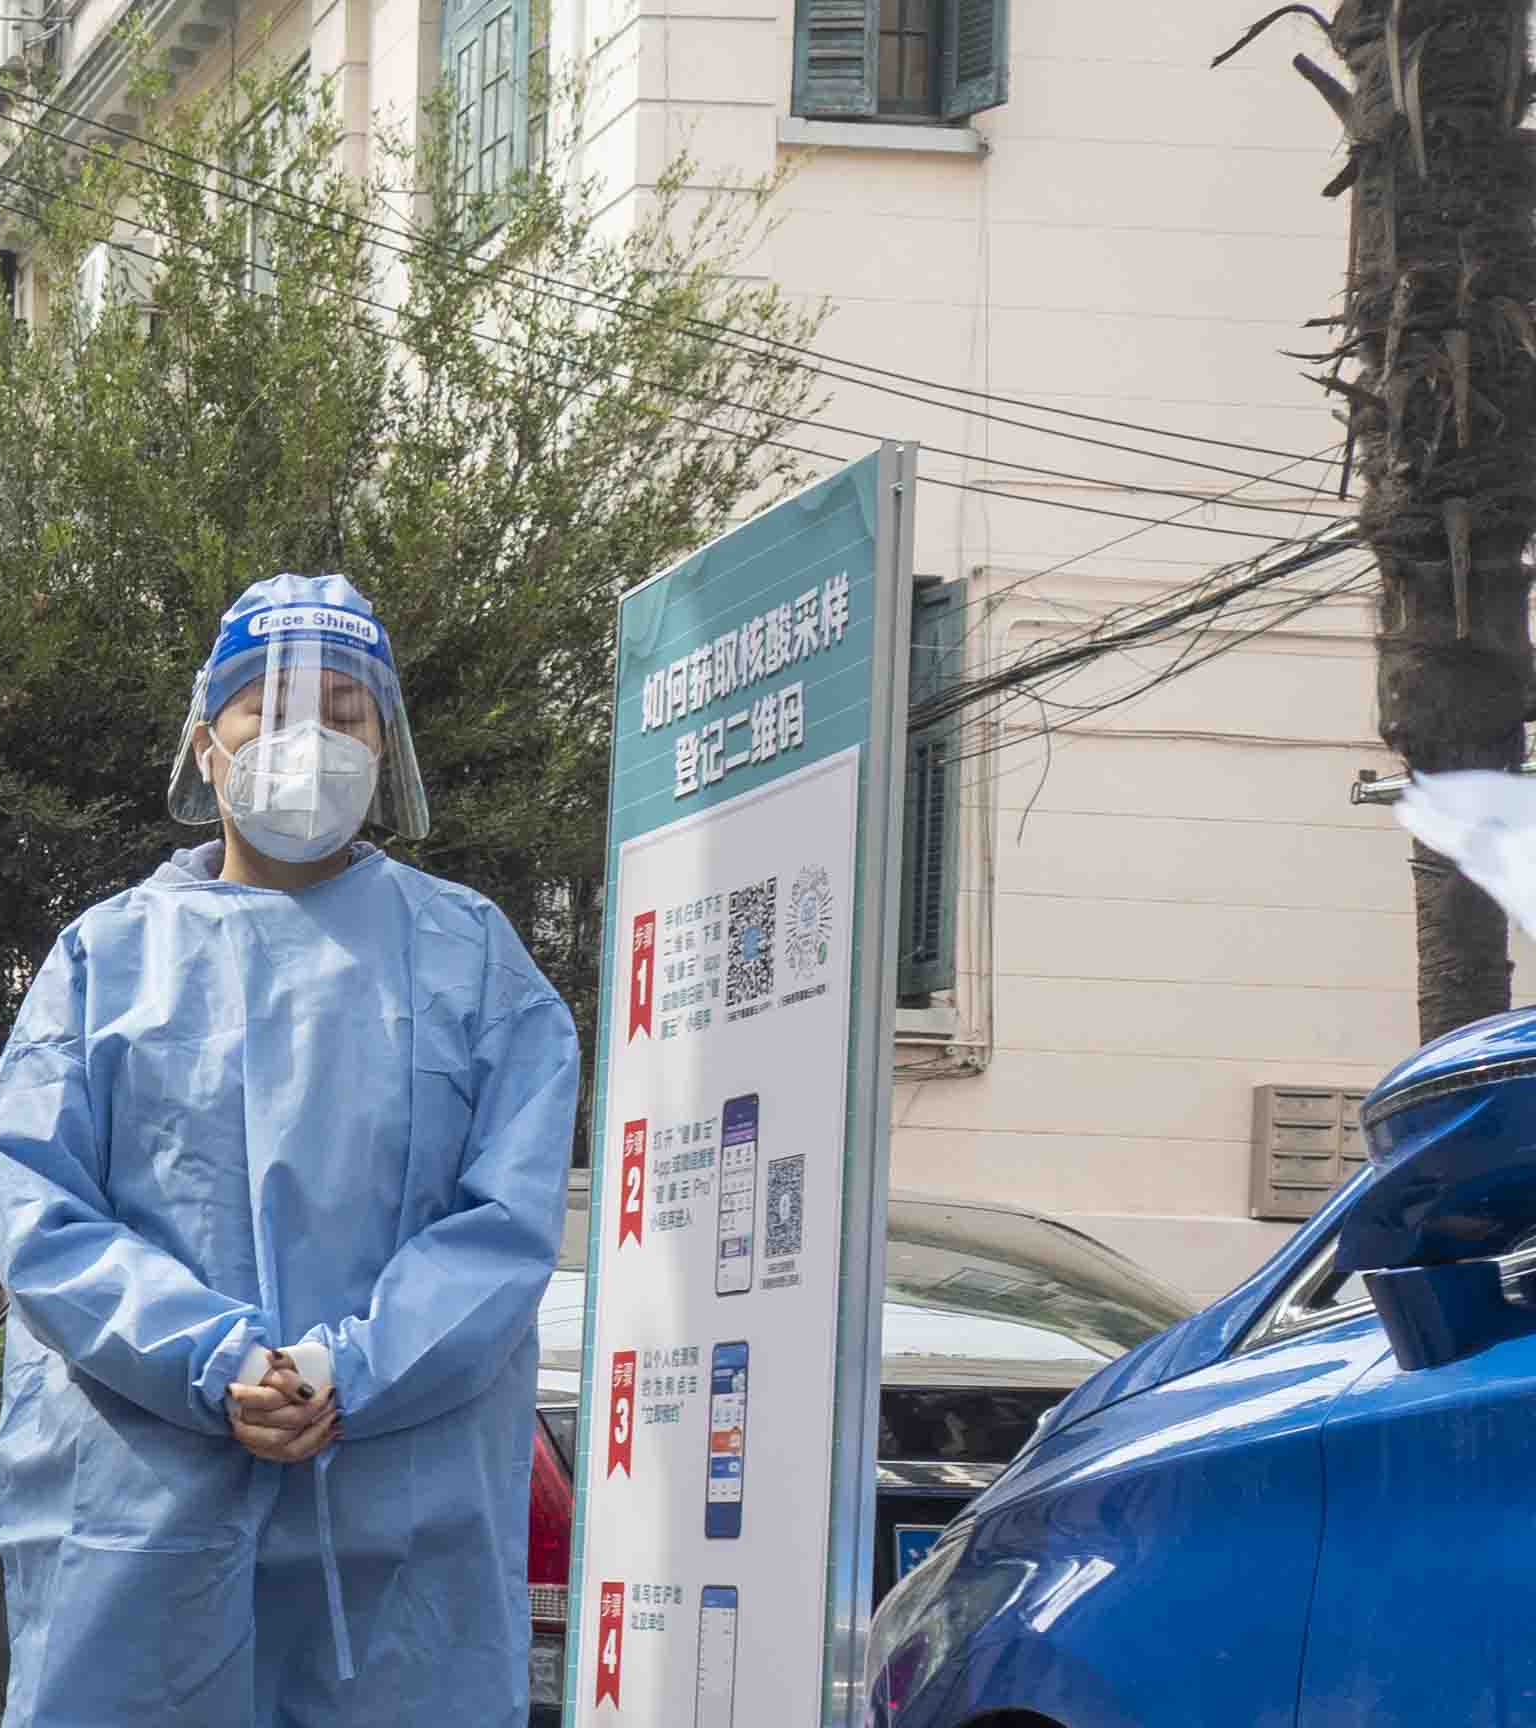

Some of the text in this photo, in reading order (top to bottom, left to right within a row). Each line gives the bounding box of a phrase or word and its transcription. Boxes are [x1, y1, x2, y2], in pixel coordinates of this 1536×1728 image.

[258, 611, 372, 638] Face Shield
[640, 569, 849, 733] 如何获取核酸采样
[674, 679, 804, 799] 登记二维码
[636, 959, 647, 1006] 1
[625, 1166, 642, 1214] 2
[614, 1397, 630, 1444] 3
[602, 1628, 618, 1675] 4
